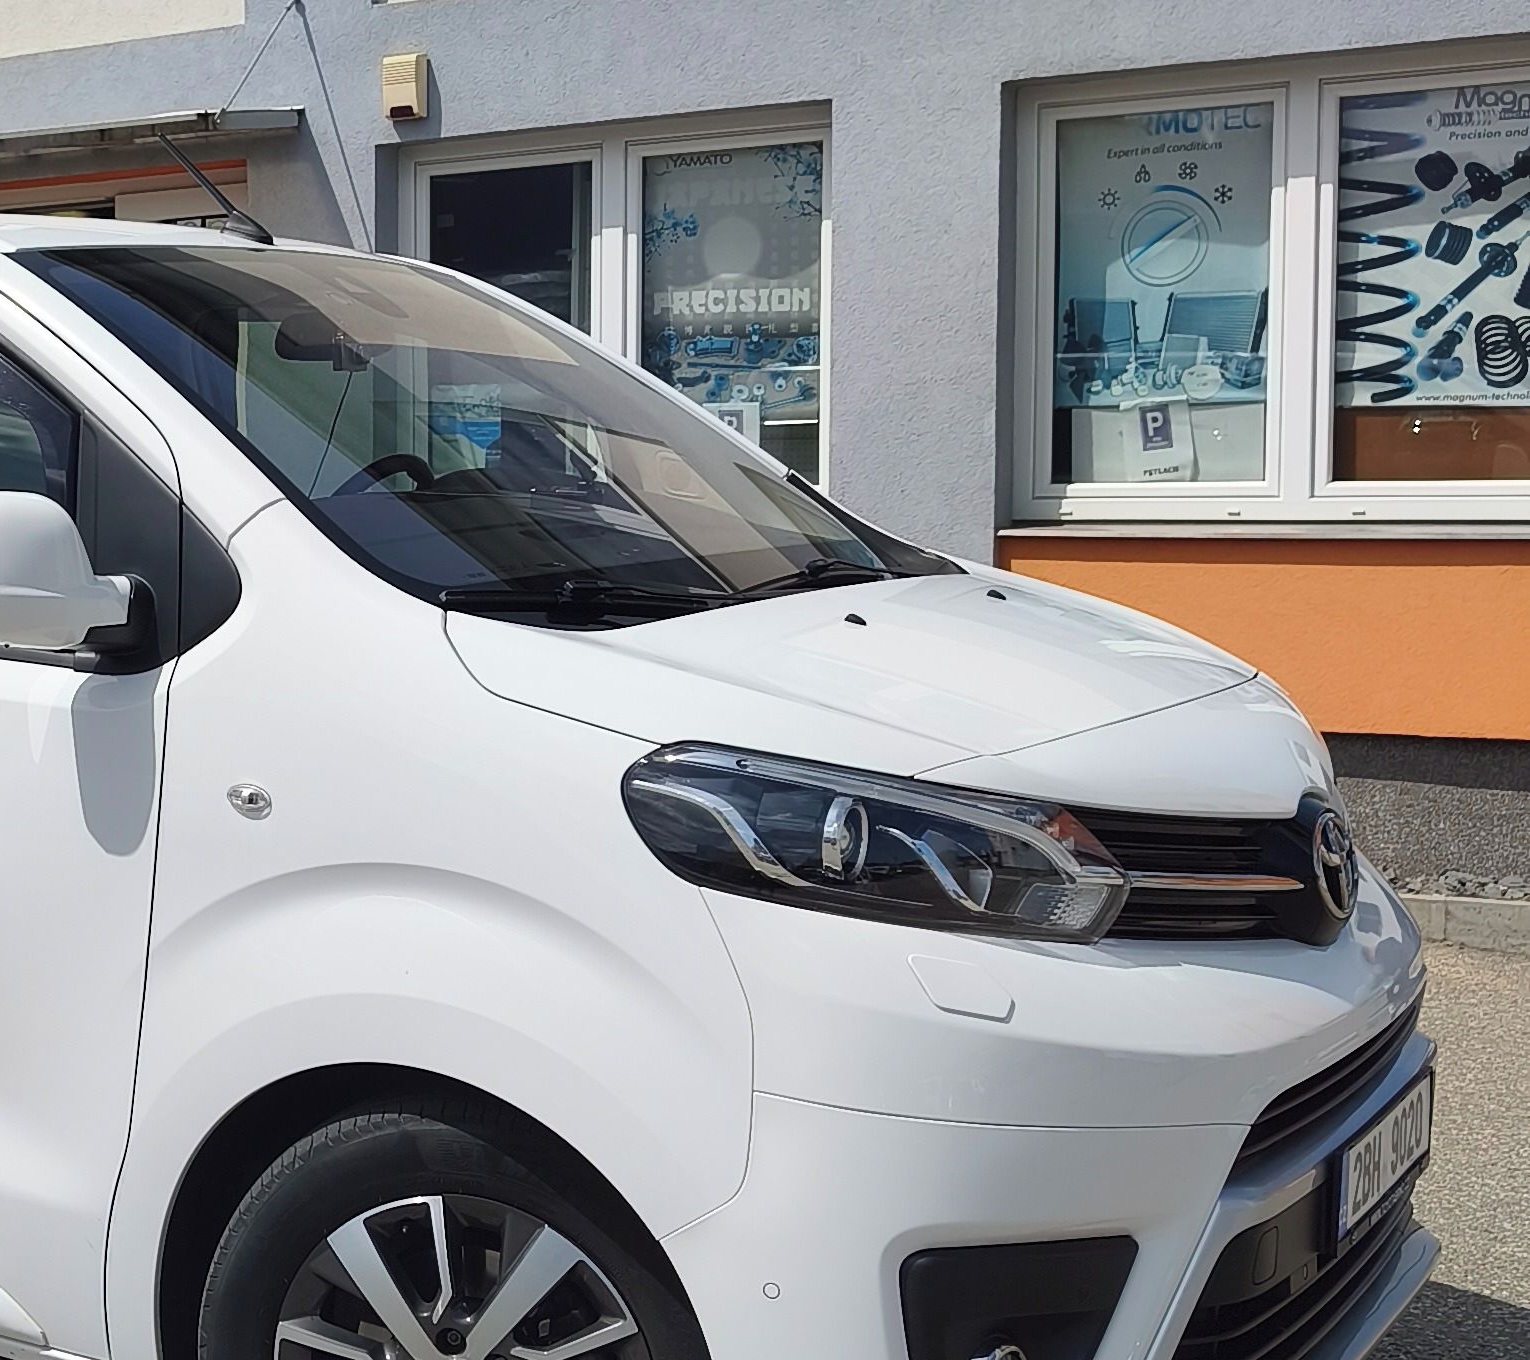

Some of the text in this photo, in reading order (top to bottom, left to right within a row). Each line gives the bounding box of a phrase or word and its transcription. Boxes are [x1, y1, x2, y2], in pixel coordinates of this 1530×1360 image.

[1449, 126, 1529, 140] Precision and
[670, 153, 733, 168] YAMATO
[1106, 141, 1223, 159] Expert in all conditions
[653, 287, 811, 316] PRECISION
[1146, 411, 1164, 437] P
[1351, 1131, 1382, 1217] 2BH
[1390, 1091, 1423, 1176] 9020
